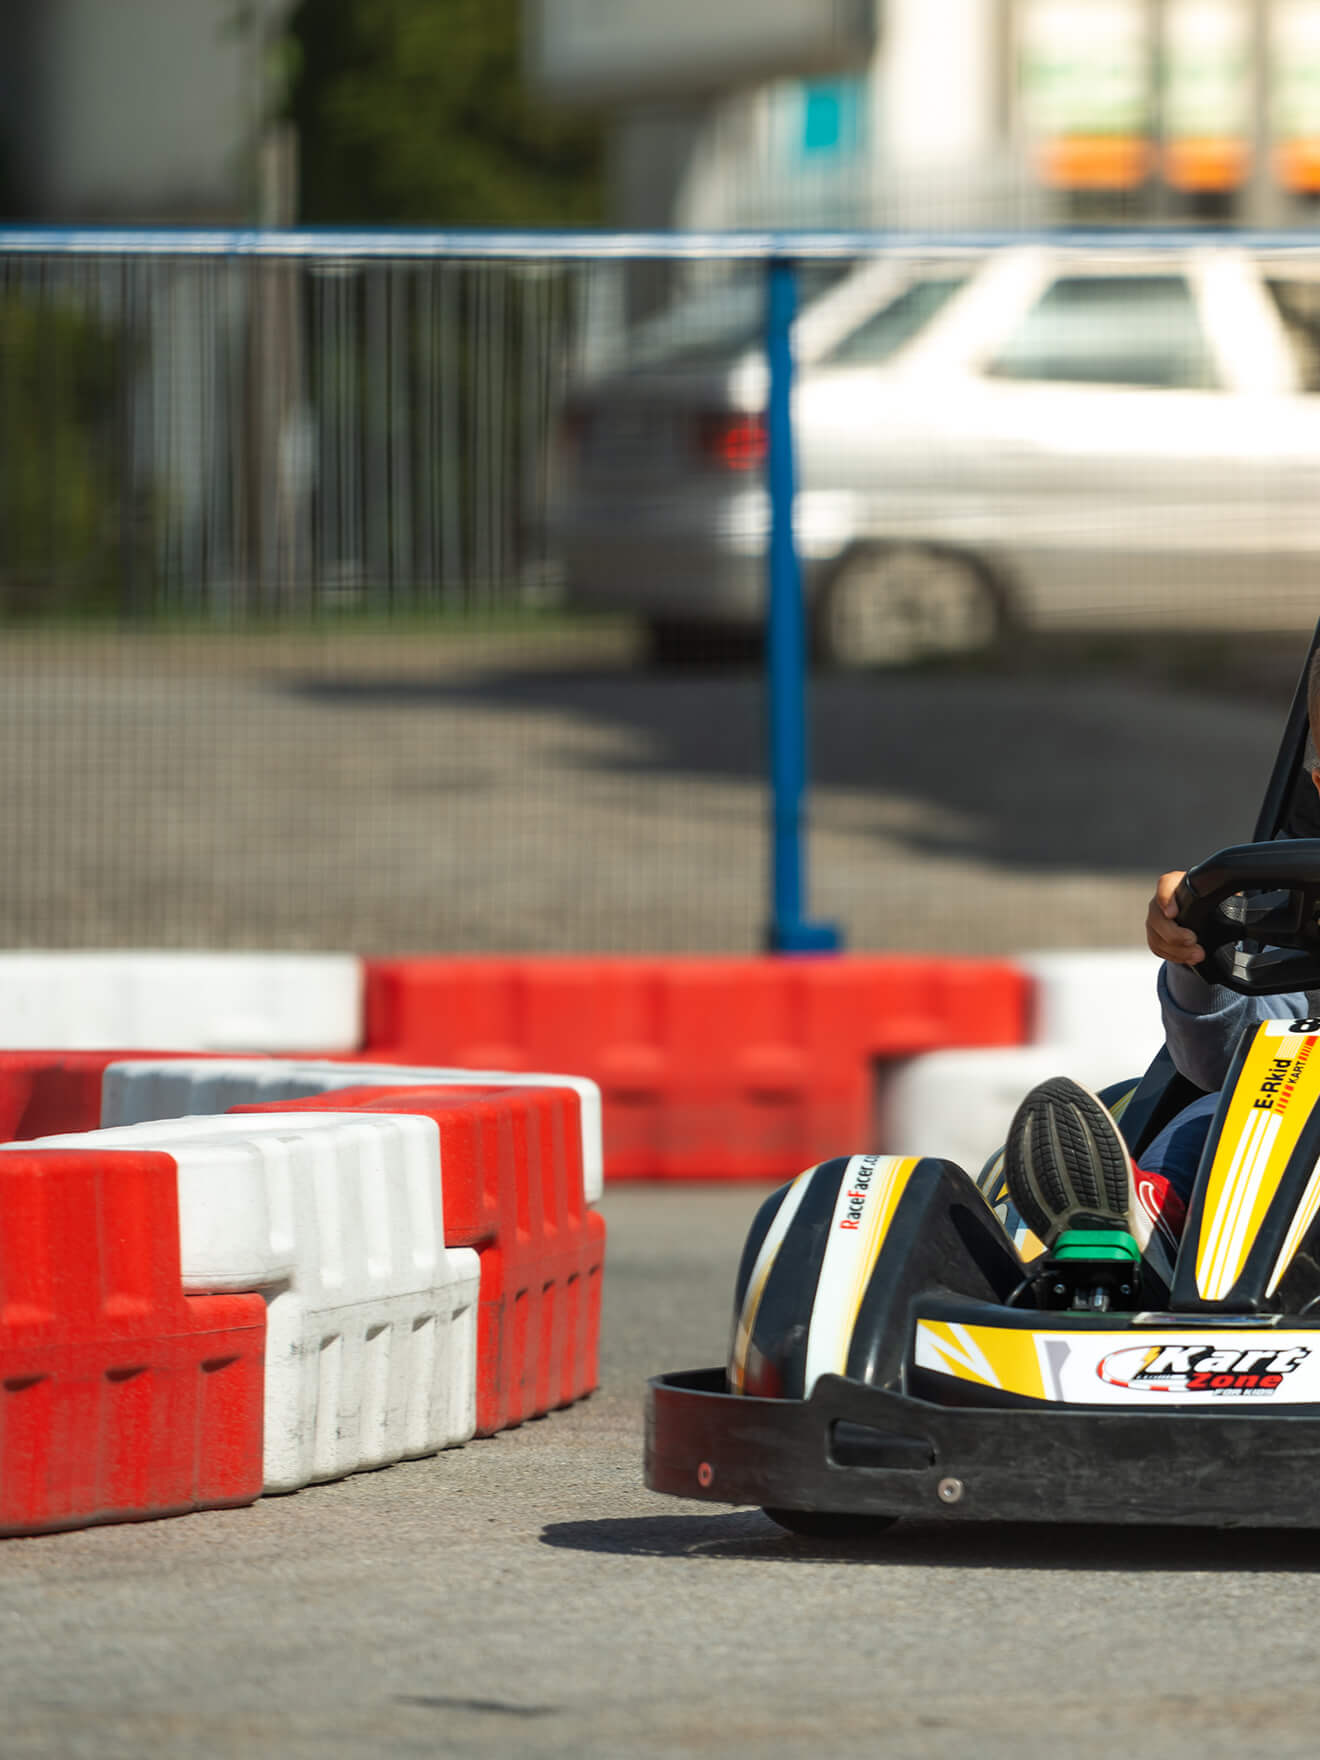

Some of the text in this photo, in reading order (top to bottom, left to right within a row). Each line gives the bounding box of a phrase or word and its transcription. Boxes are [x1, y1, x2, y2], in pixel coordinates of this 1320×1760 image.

[1254, 1058, 1292, 1109] E-Rkid
[1289, 1060, 1306, 1084] KART
[1144, 1345, 1312, 1373] Kart
